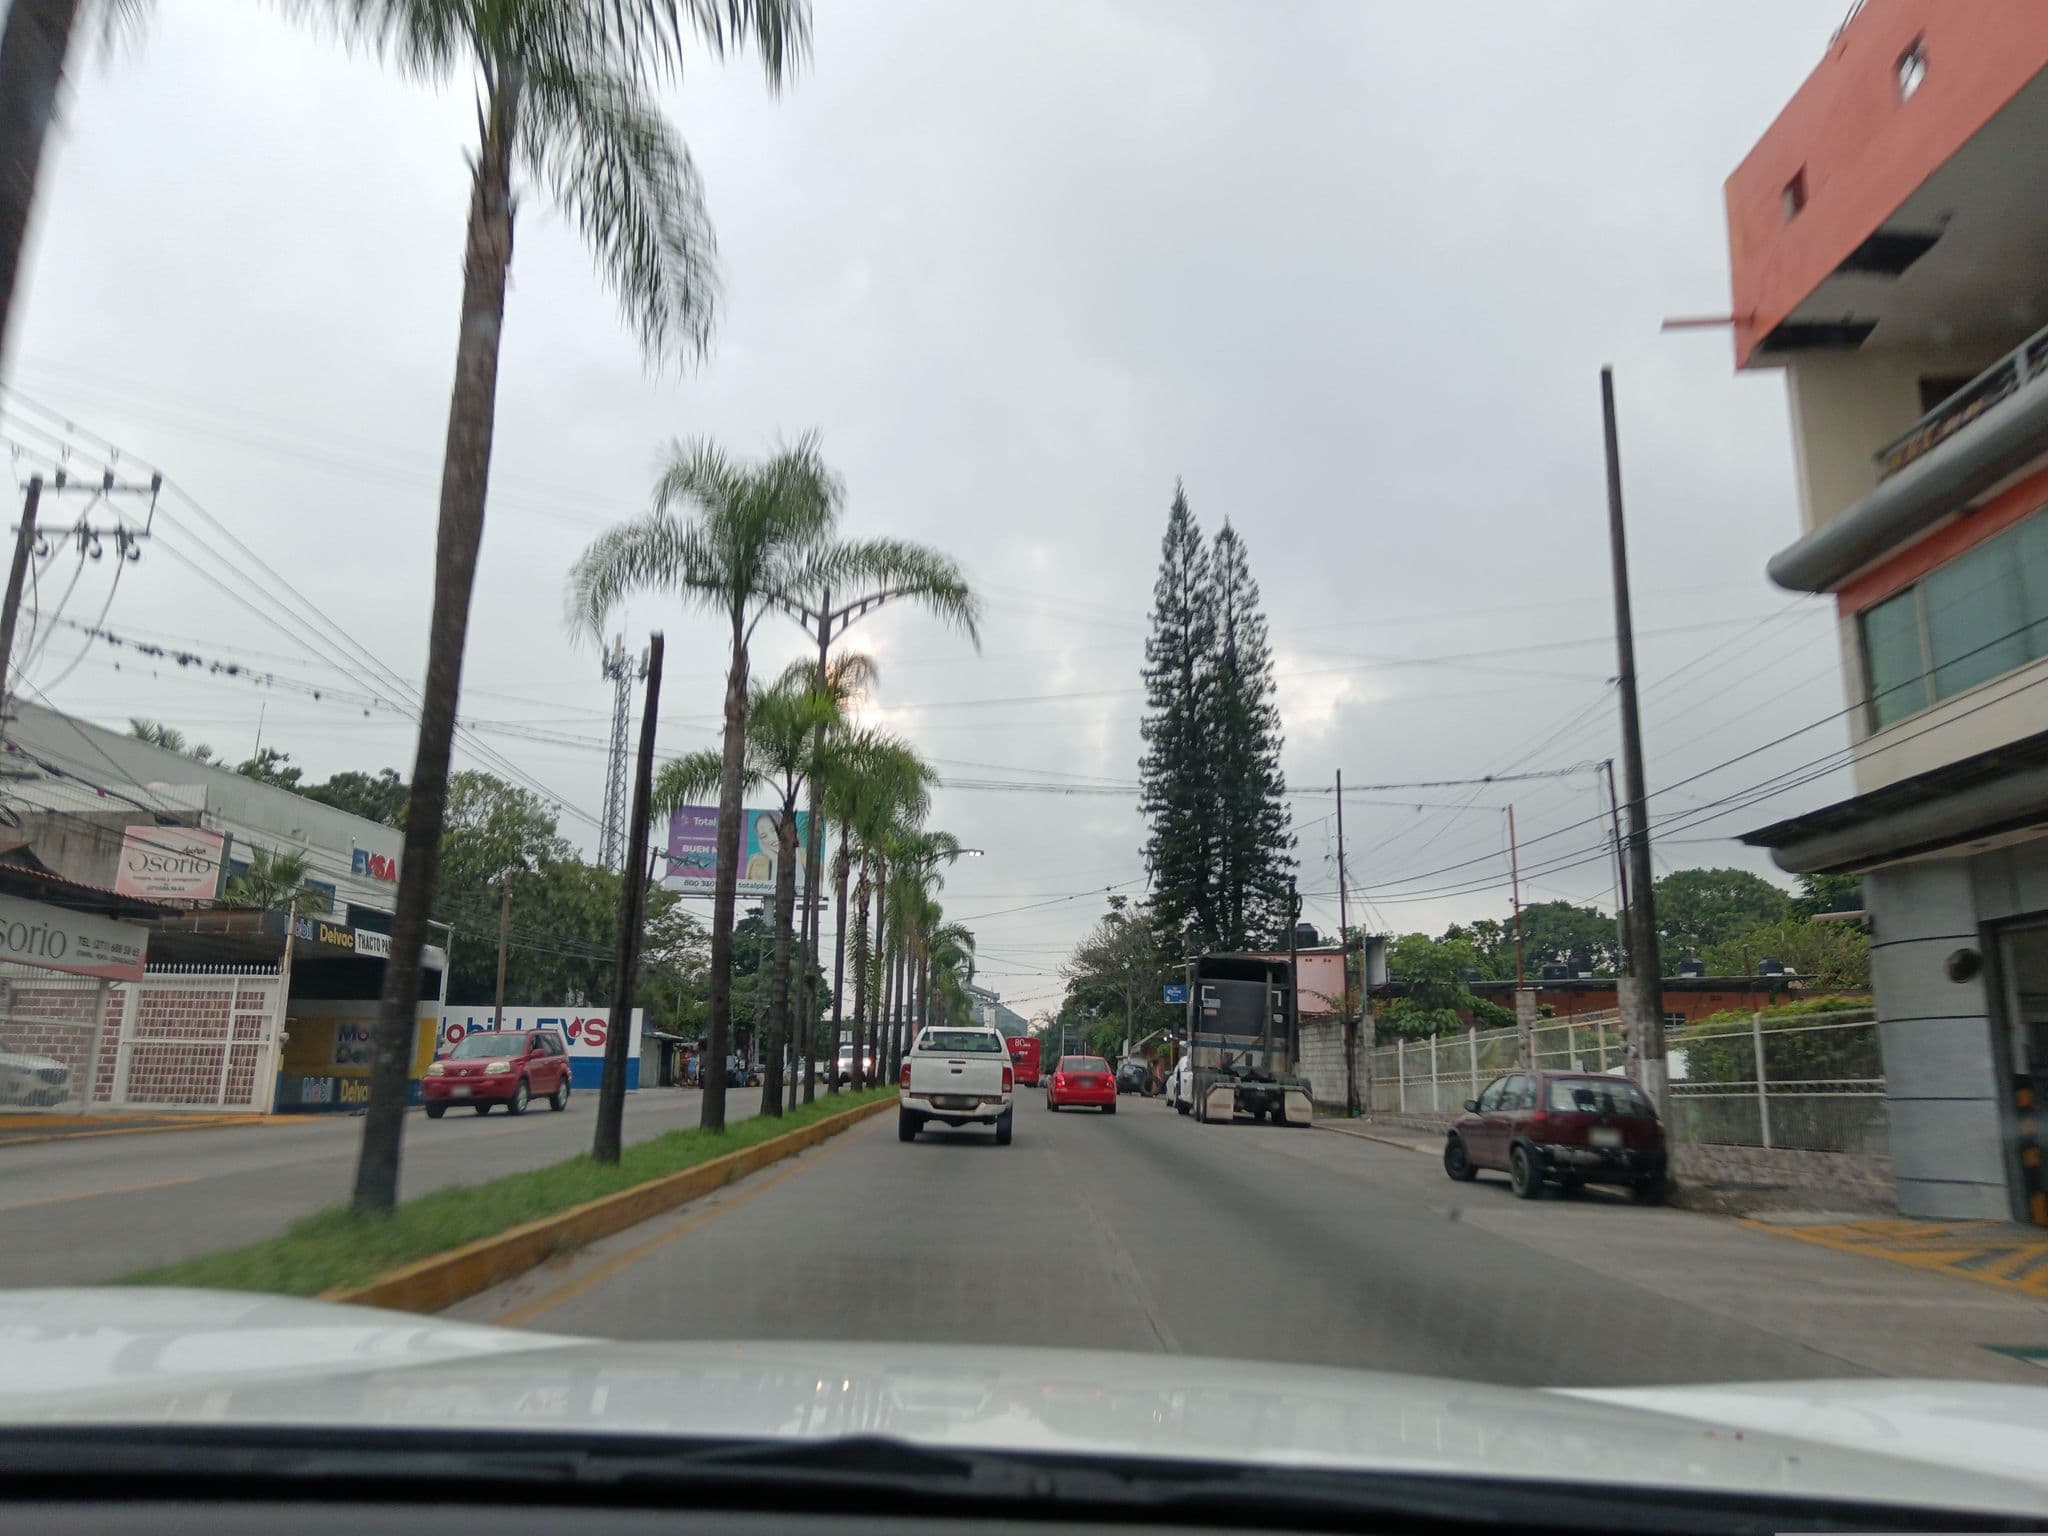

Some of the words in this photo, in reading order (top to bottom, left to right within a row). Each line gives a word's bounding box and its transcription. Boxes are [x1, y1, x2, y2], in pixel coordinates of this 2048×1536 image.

[693, 816, 719, 827] Total
[320, 923, 354, 949] Delvac
[357, 933, 381, 952] TRACTO
[341, 1079, 369, 1104] Delva
